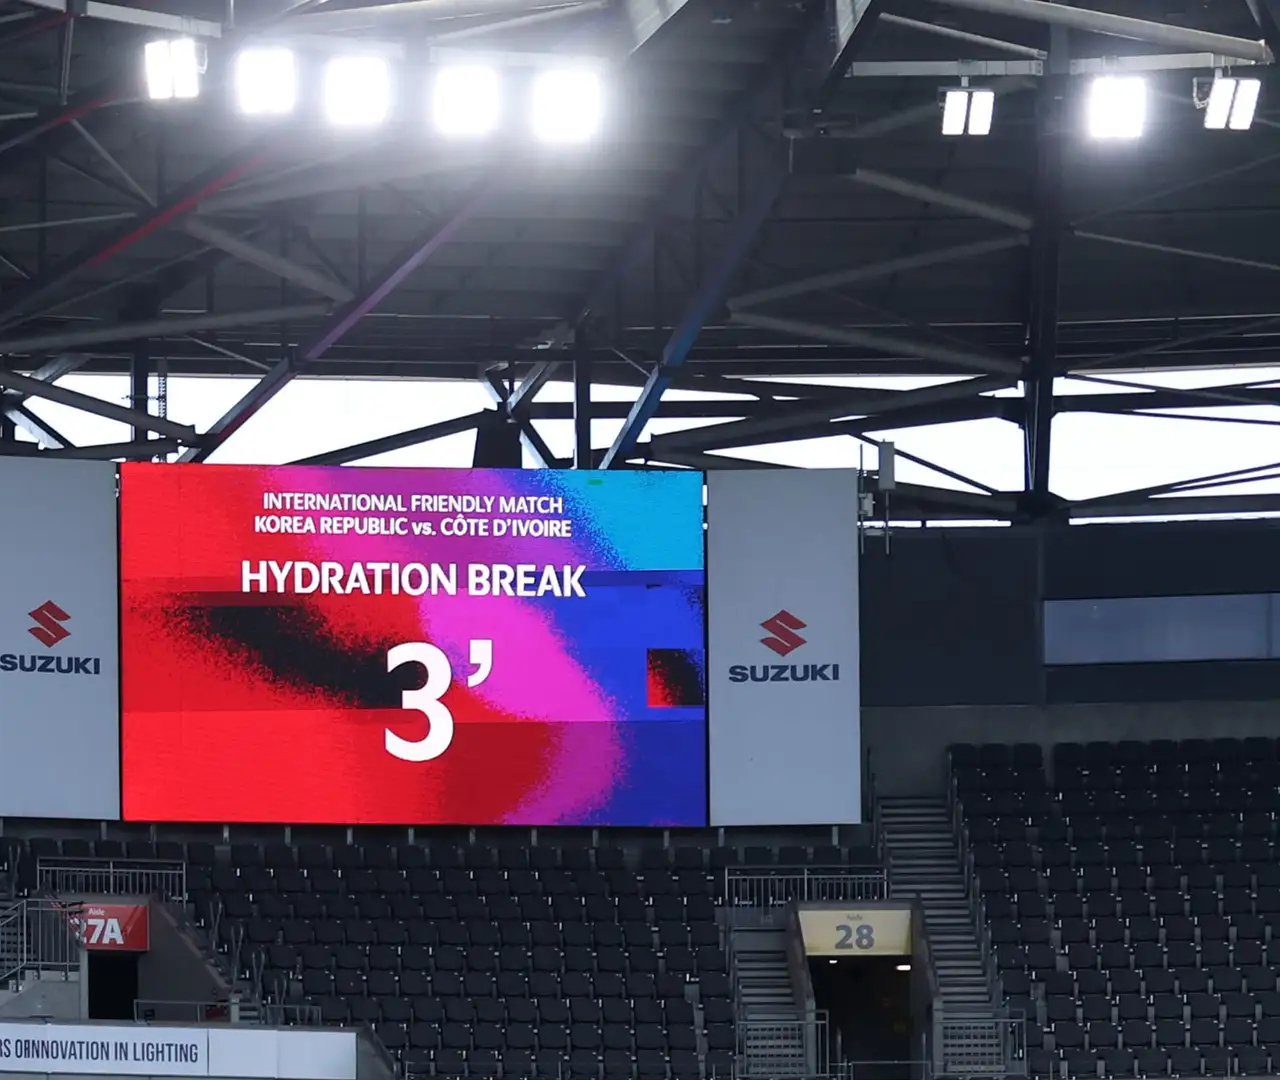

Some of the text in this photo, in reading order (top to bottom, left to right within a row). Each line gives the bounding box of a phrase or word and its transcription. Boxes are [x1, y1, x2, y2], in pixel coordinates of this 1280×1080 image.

[263, 493, 563, 514] INTERNATIONAL FRIENDLY MATCH
[254, 514, 572, 538] KOREA REPUBLIC vs. CÔTE D'IVOIRE
[241, 560, 587, 598] HYDRATION BREAK
[0, 654, 101, 675] SUZUKI
[728, 664, 839, 683] SUZUKI
[385, 639, 493, 762] 3'
[89, 908, 106, 916] Aisle
[835, 924, 875, 950] 28
[114, 1042, 129, 1062] IN
[133, 1042, 198, 1064] LIGHTING
